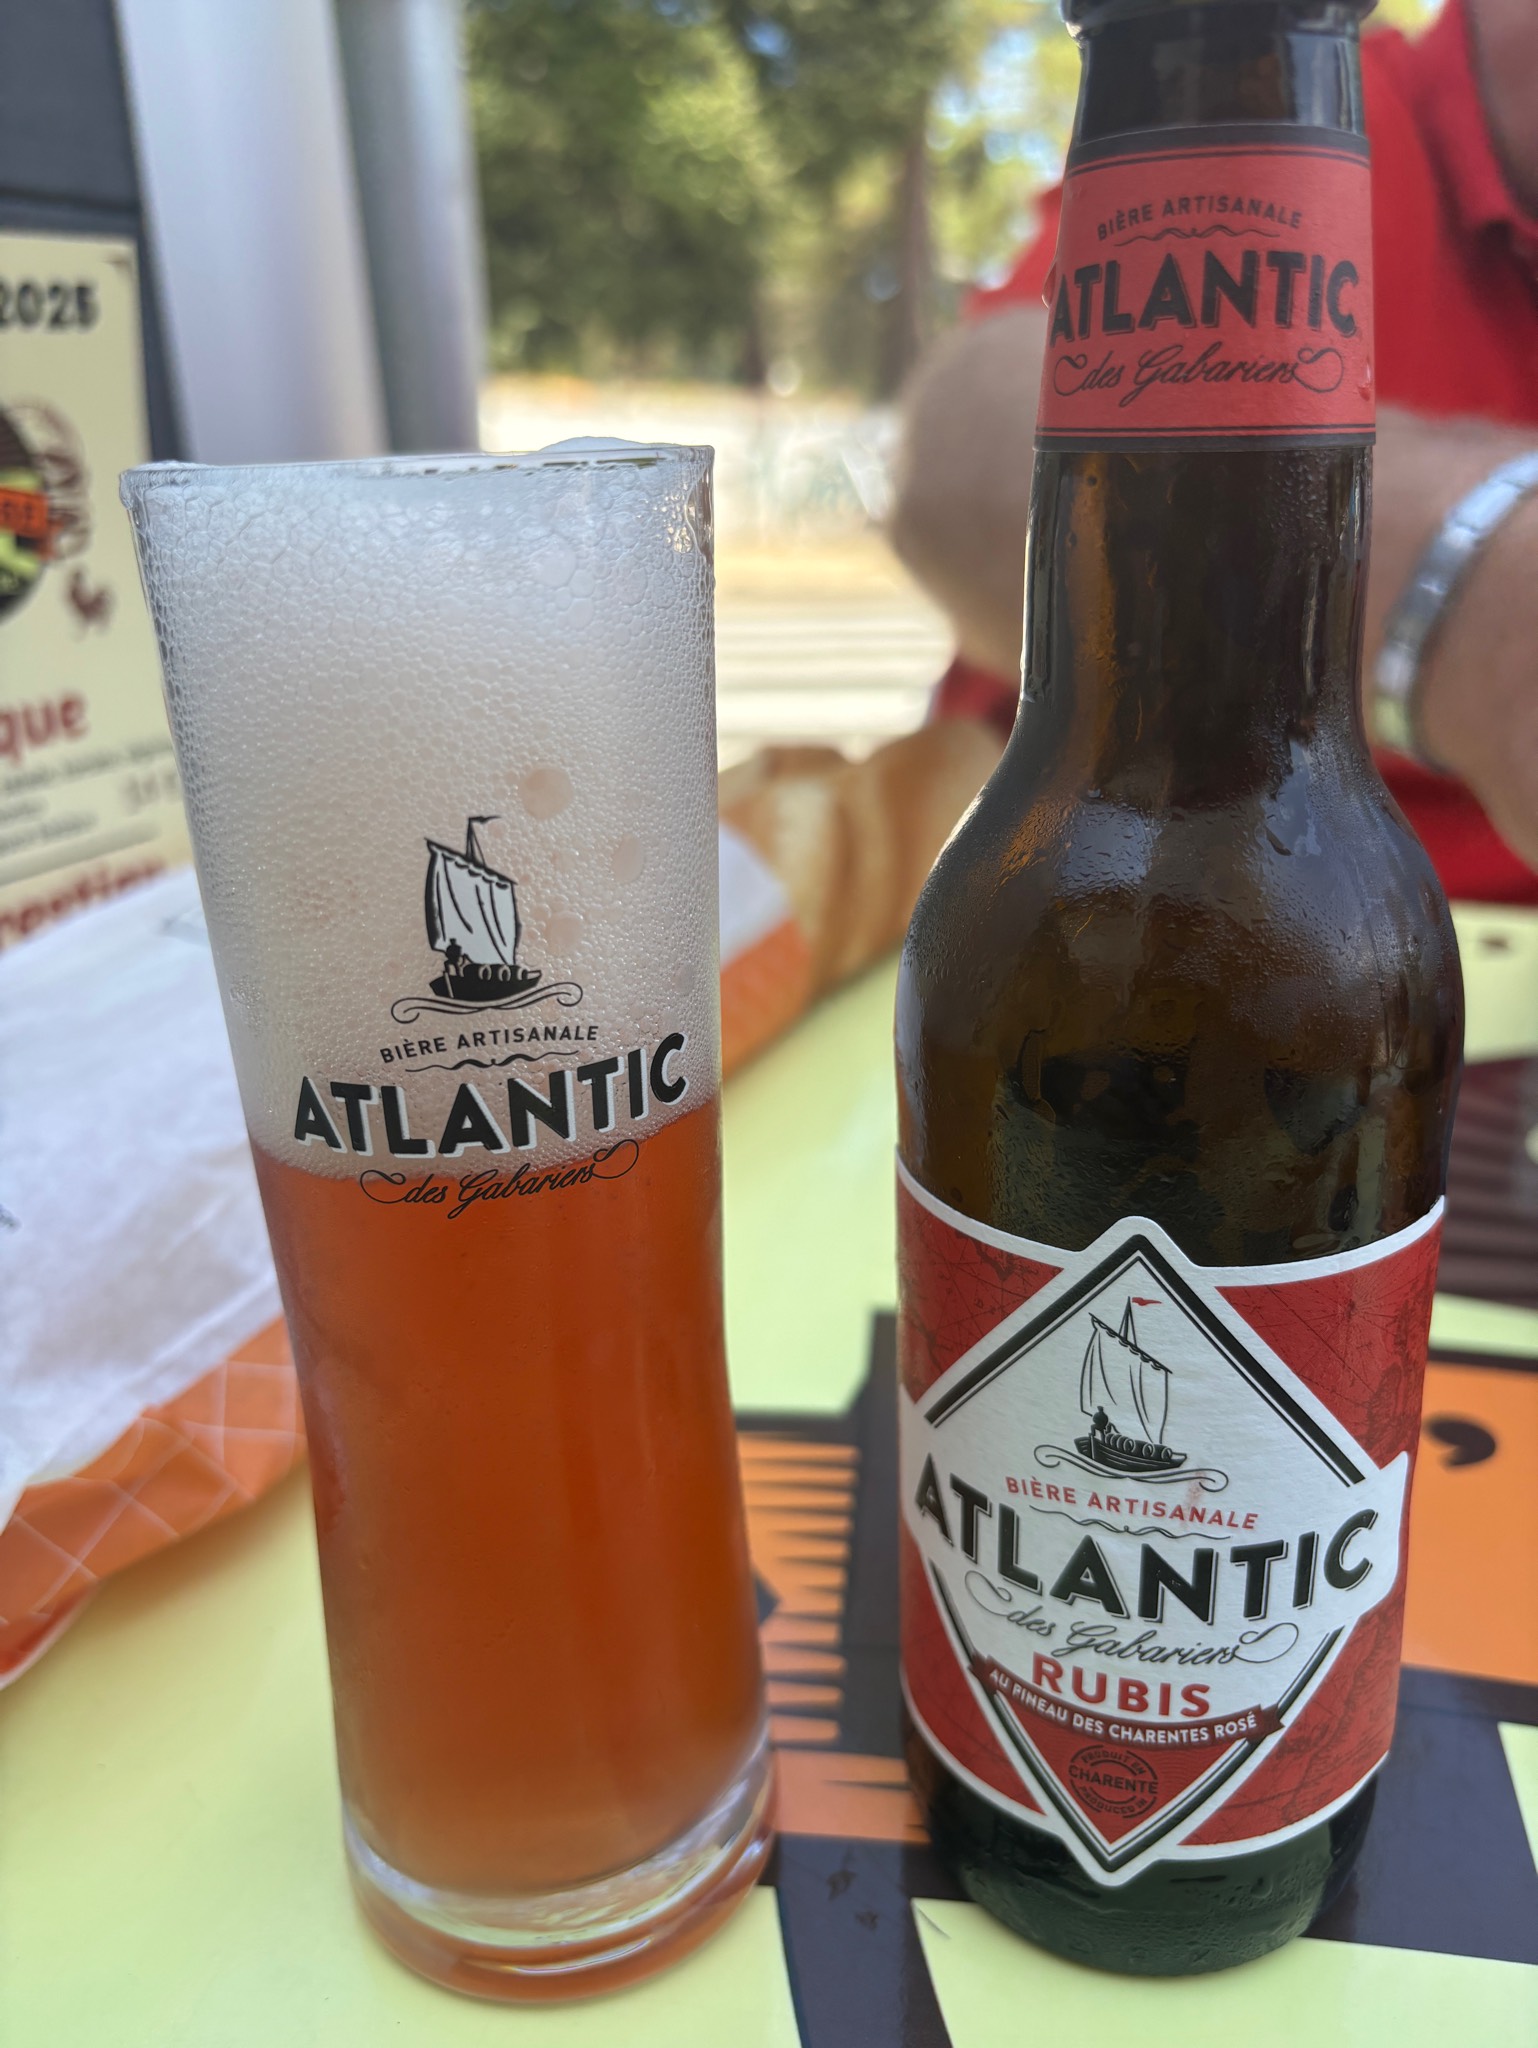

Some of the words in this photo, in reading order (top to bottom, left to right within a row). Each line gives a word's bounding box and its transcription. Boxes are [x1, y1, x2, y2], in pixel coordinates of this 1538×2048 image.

[1097, 203, 1154, 241] BIÈRE
[1162, 195, 1303, 229] ARTISANALE
[1051, 250, 1359, 348] ATLANTIC
[1070, 350, 1126, 394] des
[1119, 341, 1300, 407] Gabariers
[379, 1037, 447, 1064] BIÈRE
[457, 1025, 599, 1050] ARTISANALE
[294, 1032, 689, 1158] ATLANTIC
[385, 1172, 447, 1205] des
[447, 1155, 605, 1220] Gabariers
[1005, 1475, 1077, 1505] BIÈRE
[1087, 1491, 1259, 1531] ARTISANALE
[915, 1453, 1379, 1626] ATLANTIC
[1050, 1620, 1246, 1666] Gabariers
[989, 1667, 1009, 1689] AU
[1012, 1682, 1069, 1722] PINEAU
[1072, 1712, 1104, 1735] DES
[1108, 1723, 1210, 1745] CHARENTES
[1213, 1711, 1258, 1738] ROSÉ
[1031, 1651, 1213, 1718] RUBIS
[1069, 1764, 1158, 1795] CHARENTE
